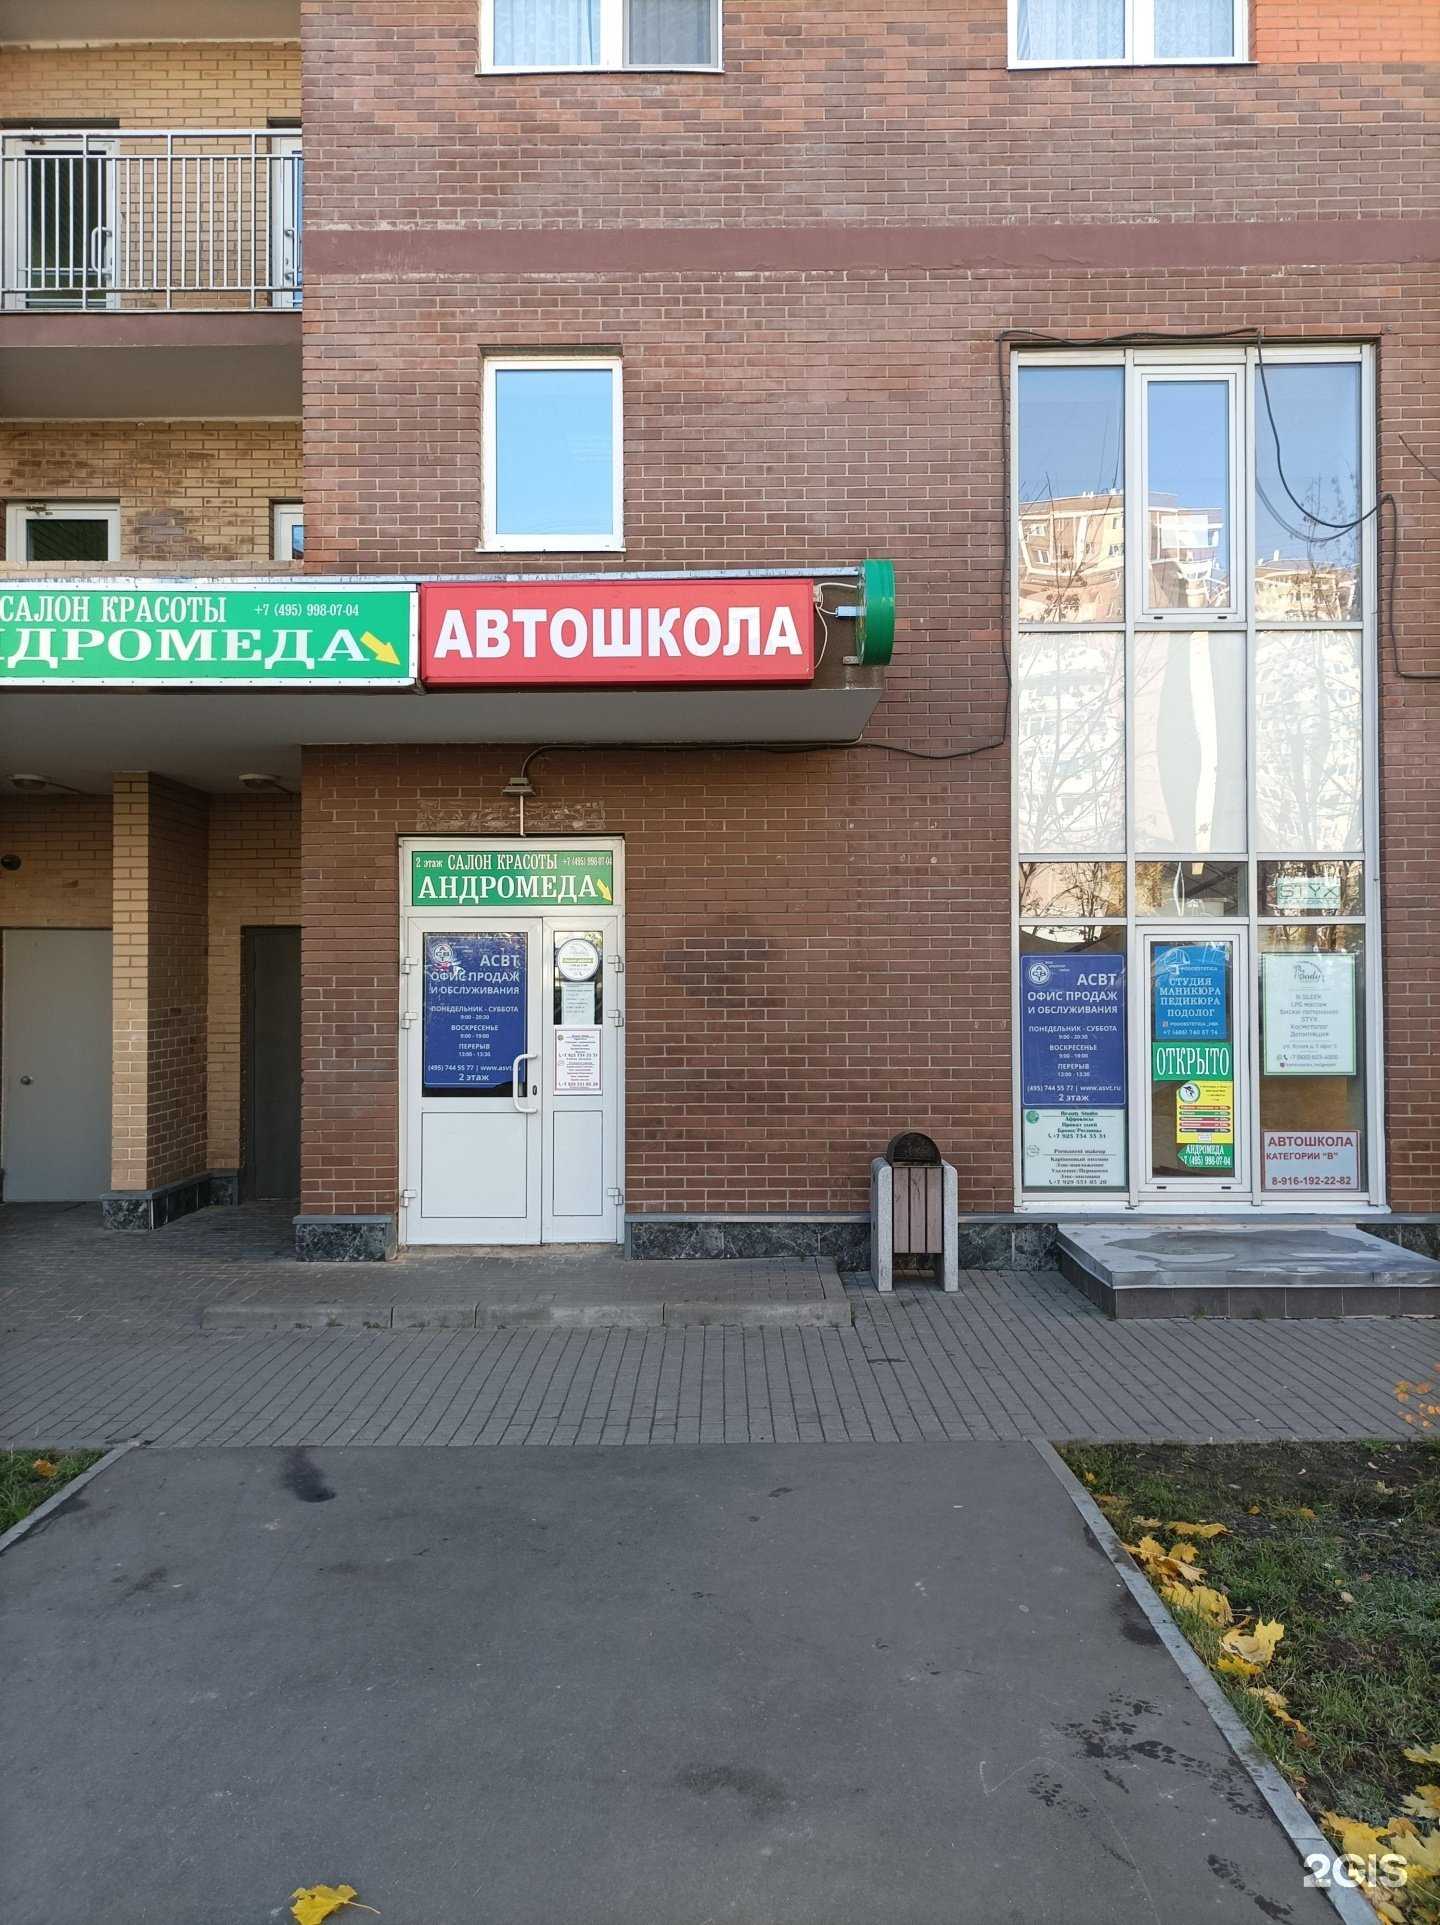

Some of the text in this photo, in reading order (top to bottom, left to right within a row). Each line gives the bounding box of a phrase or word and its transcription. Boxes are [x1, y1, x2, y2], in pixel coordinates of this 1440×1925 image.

[0, 595, 227, 623] САЛОН КРАСОТЫ
[255, 602, 359, 617] +7 (495) 998-07-04
[433, 606, 803, 658] АВТОШКОЛА
[0, 628, 370, 669] ДРОМЕДА
[416, 858, 443, 868] 2 этаж
[448, 854, 558, 870] САЛОН КРАСОТЫ
[418, 875, 598, 904] АНДРОМЕДА
[480, 954, 520, 967] АСВТ
[431, 971, 520, 984] ОФИС ПРОДАЖ
[1077, 973, 1117, 986] АСВТ
[1169, 977, 1212, 987] СТУДИЯ
[431, 986, 520, 995] И ОБСЛУЖИВАНИЯ
[1160, 987, 1221, 996] МАНИКЮРА
[1027, 991, 1118, 1003] ОФИС ПРОДАЖ
[1160, 997, 1220, 1006] ПЕДИКЮРА
[430, 1006, 484, 1014] ПОНЕДЕЛЬНИК
[1028, 1006, 1118, 1014] И ОБСЛУЖИВАНИЯ
[1167, 1009, 1215, 1018] ПОДОЛОГ
[1028, 1026, 1081, 1034] ПОНЕДЕЛЬНИК
[1156, 1047, 1229, 1076] ОТКРЫТО
[427, 1064, 444, 1072] (495)
[459, 1073, 464, 1081] 2
[1268, 1136, 1353, 1147] АВТОШКОЛА
[1266, 1152, 1320, 1160] КАТЕГОРИИ
[1272, 1176, 1351, 1185] 8-916-192-22-82
